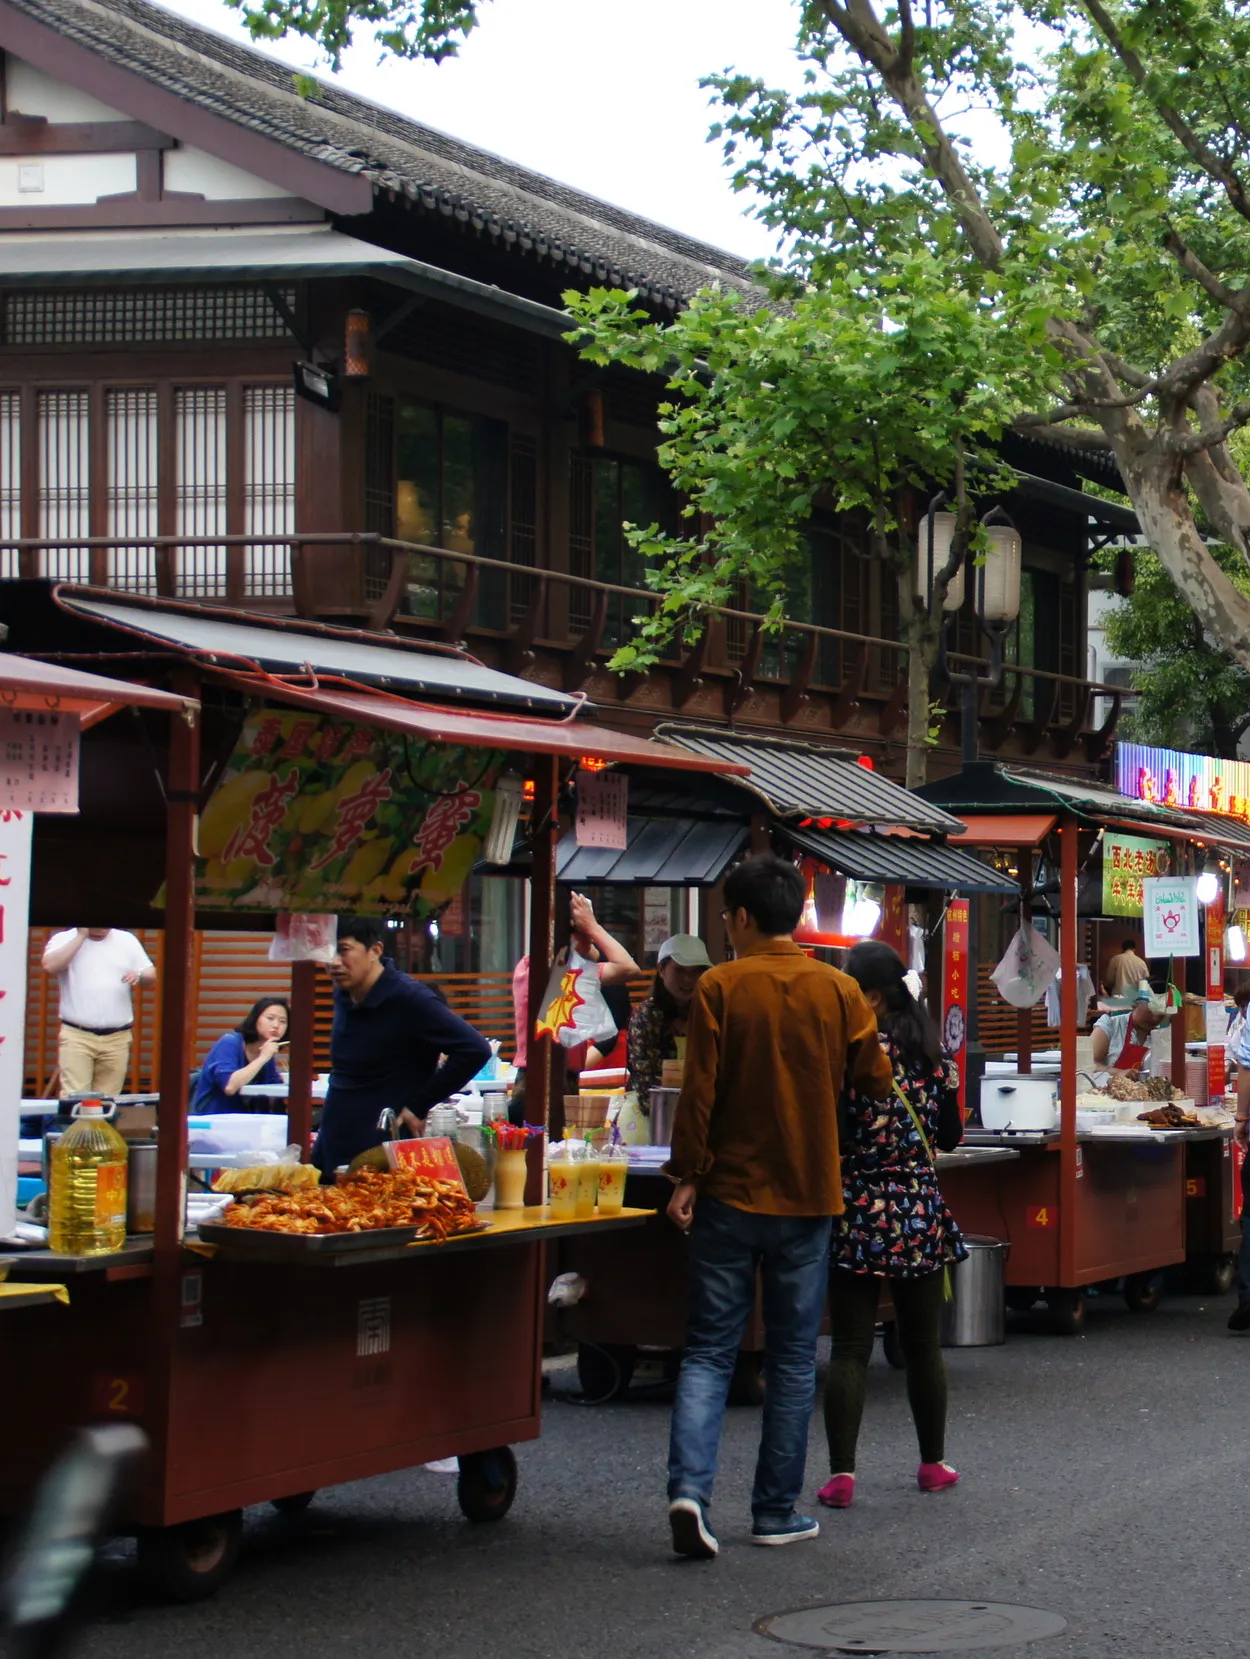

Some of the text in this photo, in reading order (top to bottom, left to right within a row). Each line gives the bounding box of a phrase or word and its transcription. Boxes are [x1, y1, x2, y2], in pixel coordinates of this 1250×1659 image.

[221, 767, 482, 875] 菠萝蜜
[1112, 845, 1156, 874] 西北老汤
[1186, 1179, 1197, 1195] 5
[1035, 1208, 1049, 1226] 4
[109, 1379, 129, 1411] 2
